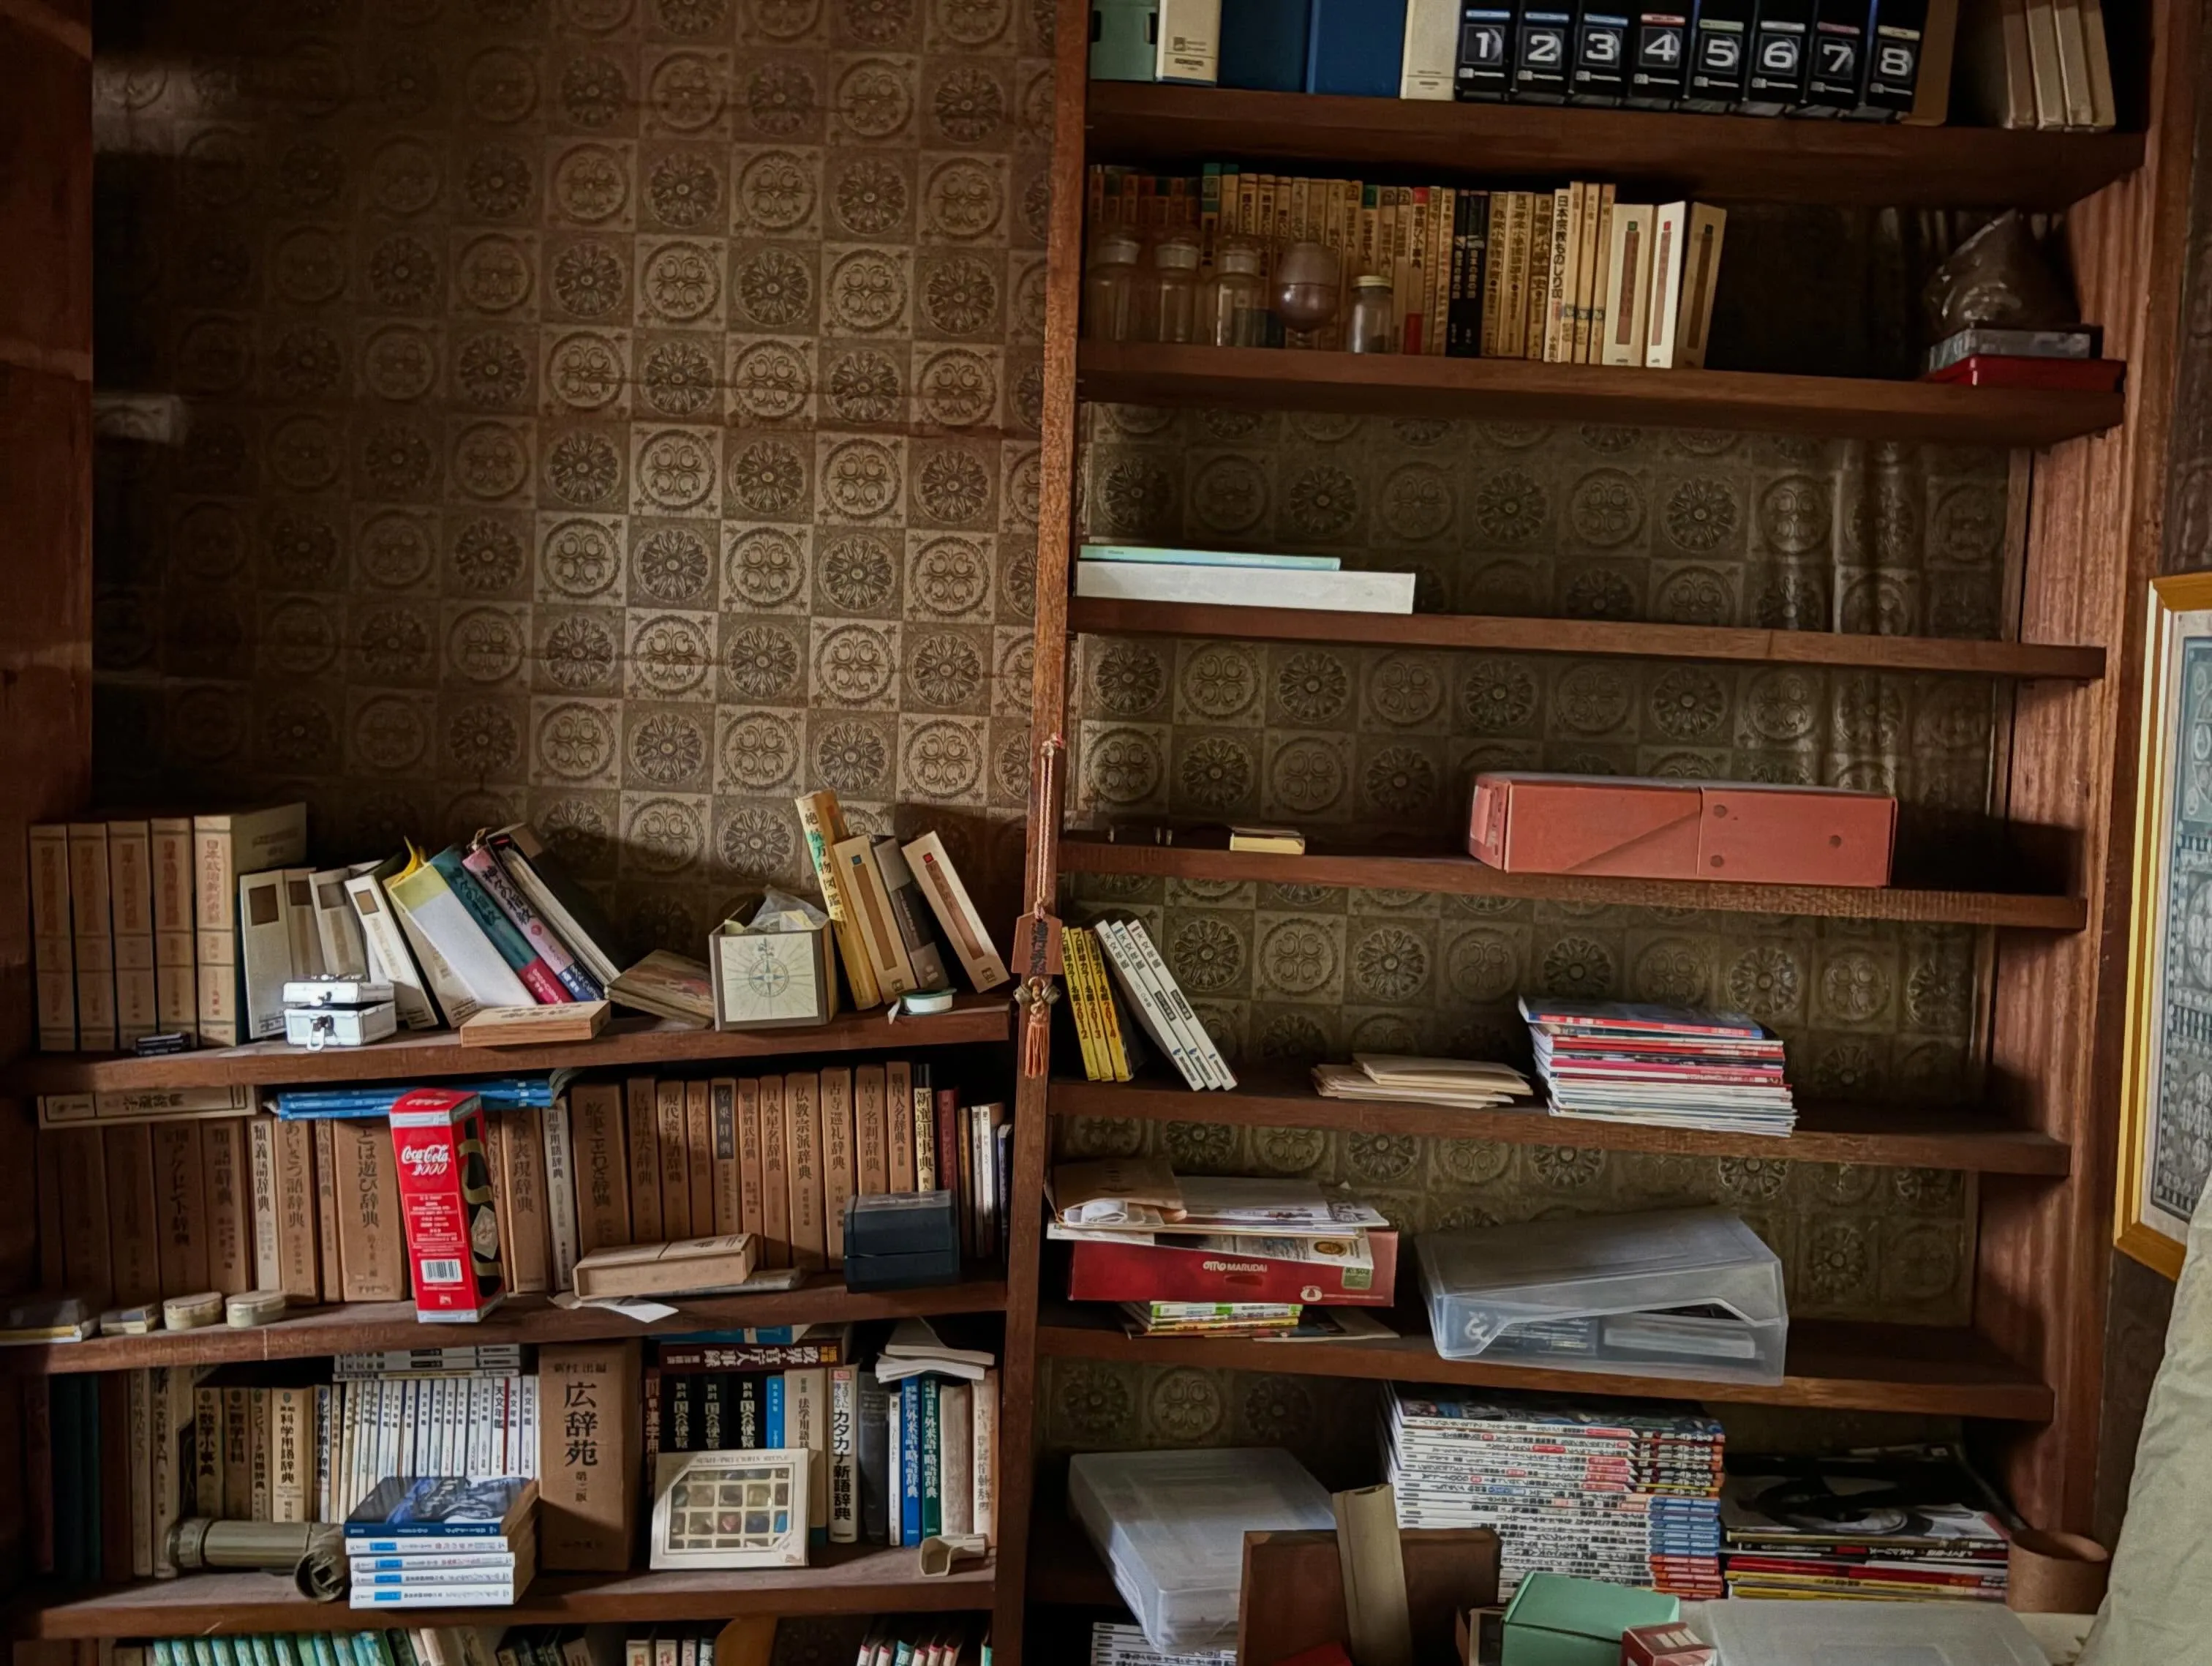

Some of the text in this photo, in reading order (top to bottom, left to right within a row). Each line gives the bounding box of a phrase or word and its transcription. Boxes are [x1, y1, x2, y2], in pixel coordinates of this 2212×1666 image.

[1475, 32, 1489, 58] 1
[1527, 34, 1557, 61] 2
[1586, 33, 1614, 60] 3
[1644, 34, 1677, 61] 4
[1706, 40, 1735, 67] 5
[1764, 42, 1793, 69] 6
[1823, 44, 1851, 72] 7
[1881, 48, 1908, 76] 8
[482, 866, 535, 924] 神々の指紋
[1103, 931, 1129, 970] 天文年鑑
[1119, 932, 1146, 970] 天文年鑑
[1136, 932, 1162, 969] 天文年鑑
[830, 1081, 846, 1171] 古寺巡礼辞典
[864, 1078, 880, 1172] 古寺名刹辞典
[892, 1073, 907, 1145] 戦国人名辞典
[766, 1088, 780, 1172] 日本星名辞典
[795, 1087, 813, 1181] 仏教宗派辞典
[916, 1090, 933, 1172] 新選組事典
[254, 1125, 271, 1212] 類義語辞典
[402, 1144, 449, 1164] Coca-Cola
[412, 1163, 448, 1176] 2000
[357, 1127, 380, 1228] とば遊び辞典
[1227, 1264, 1268, 1273] MARUDAI
[704, 1346, 819, 1367] 政界・官庁人事録
[494, 1386, 505, 1429] 天文年鑑
[509, 1389, 518, 1427] 天文年鑑
[564, 1381, 598, 1468] 広辞苑
[832, 1410, 851, 1520] カタカナ新語辞典
[905, 1410, 919, 1498] 外来語・略語辞典
[924, 1417, 938, 1498] 外来語・略語辞典
